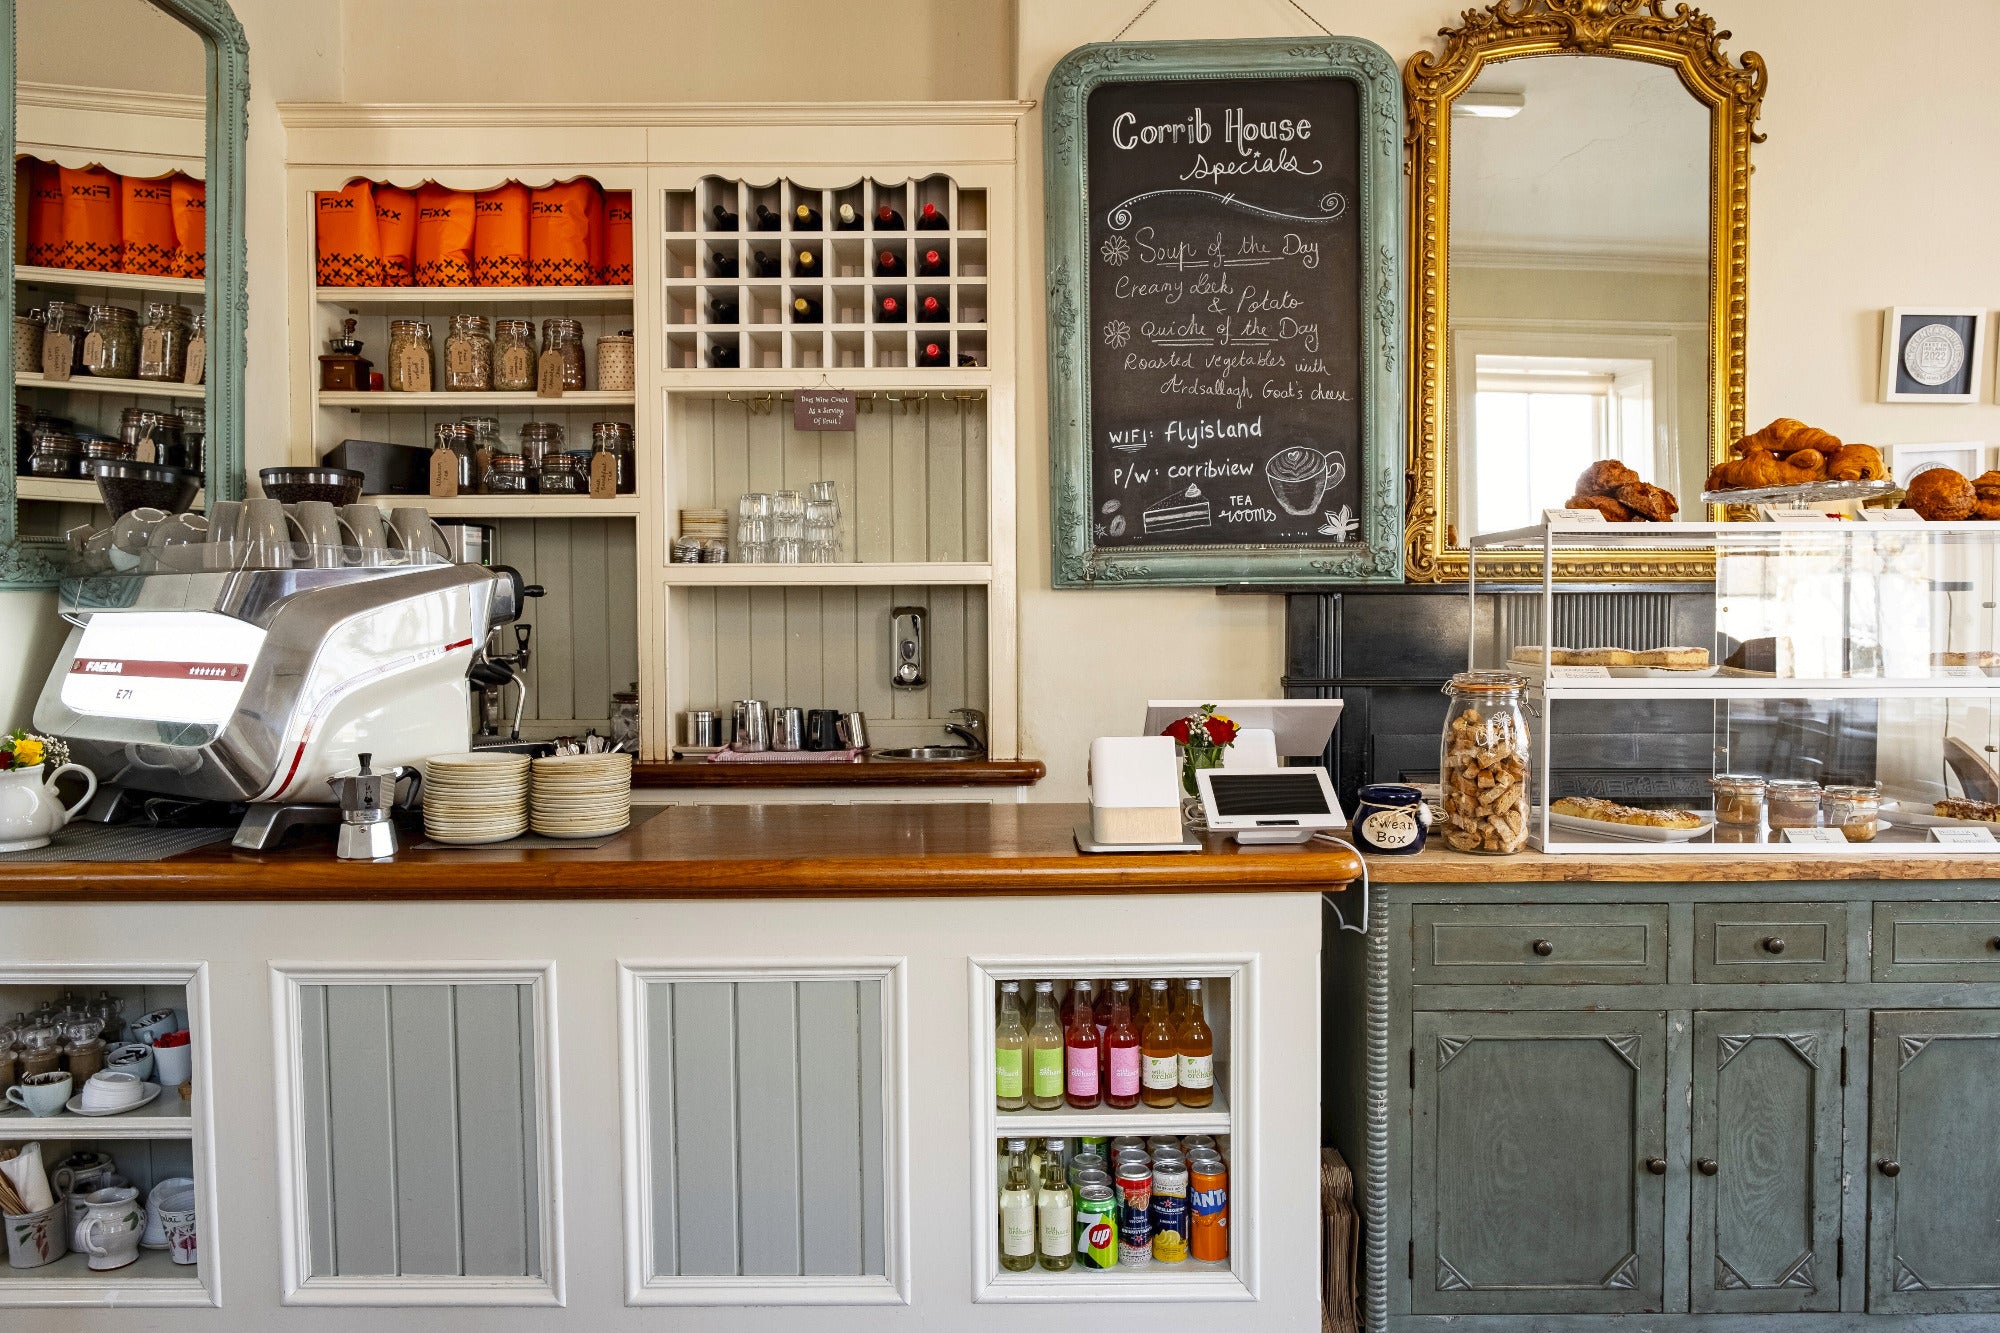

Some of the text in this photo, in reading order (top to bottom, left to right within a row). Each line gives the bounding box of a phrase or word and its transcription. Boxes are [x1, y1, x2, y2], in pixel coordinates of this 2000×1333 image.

[1112, 107, 1312, 157] Corrib House
[320, 198, 354, 210] Fixx
[532, 201, 563, 214] Fixx
[420, 207, 451, 219] Fixx
[609, 208, 632, 220] Fix
[1135, 226, 1319, 271] Soup of the Day
[1115, 275, 1184, 304] Creamy
[1207, 297, 1227, 314] &
[1236, 285, 1304, 314] Potato
[1140, 314, 1319, 353] Quiche of the Day
[1124, 350, 1331, 377] Roasted vegetables with
[1923, 351, 1946, 361] 2022
[1262, 379, 1304, 400] Goat's
[1165, 416, 1263, 449] flyisland
[1167, 458, 1254, 481] corribview
[1229, 495, 1253, 507] TEA
[1218, 507, 1278, 524] rooms
[85, 661, 123, 673] FAEMA
[1376, 831, 1406, 844] Box
